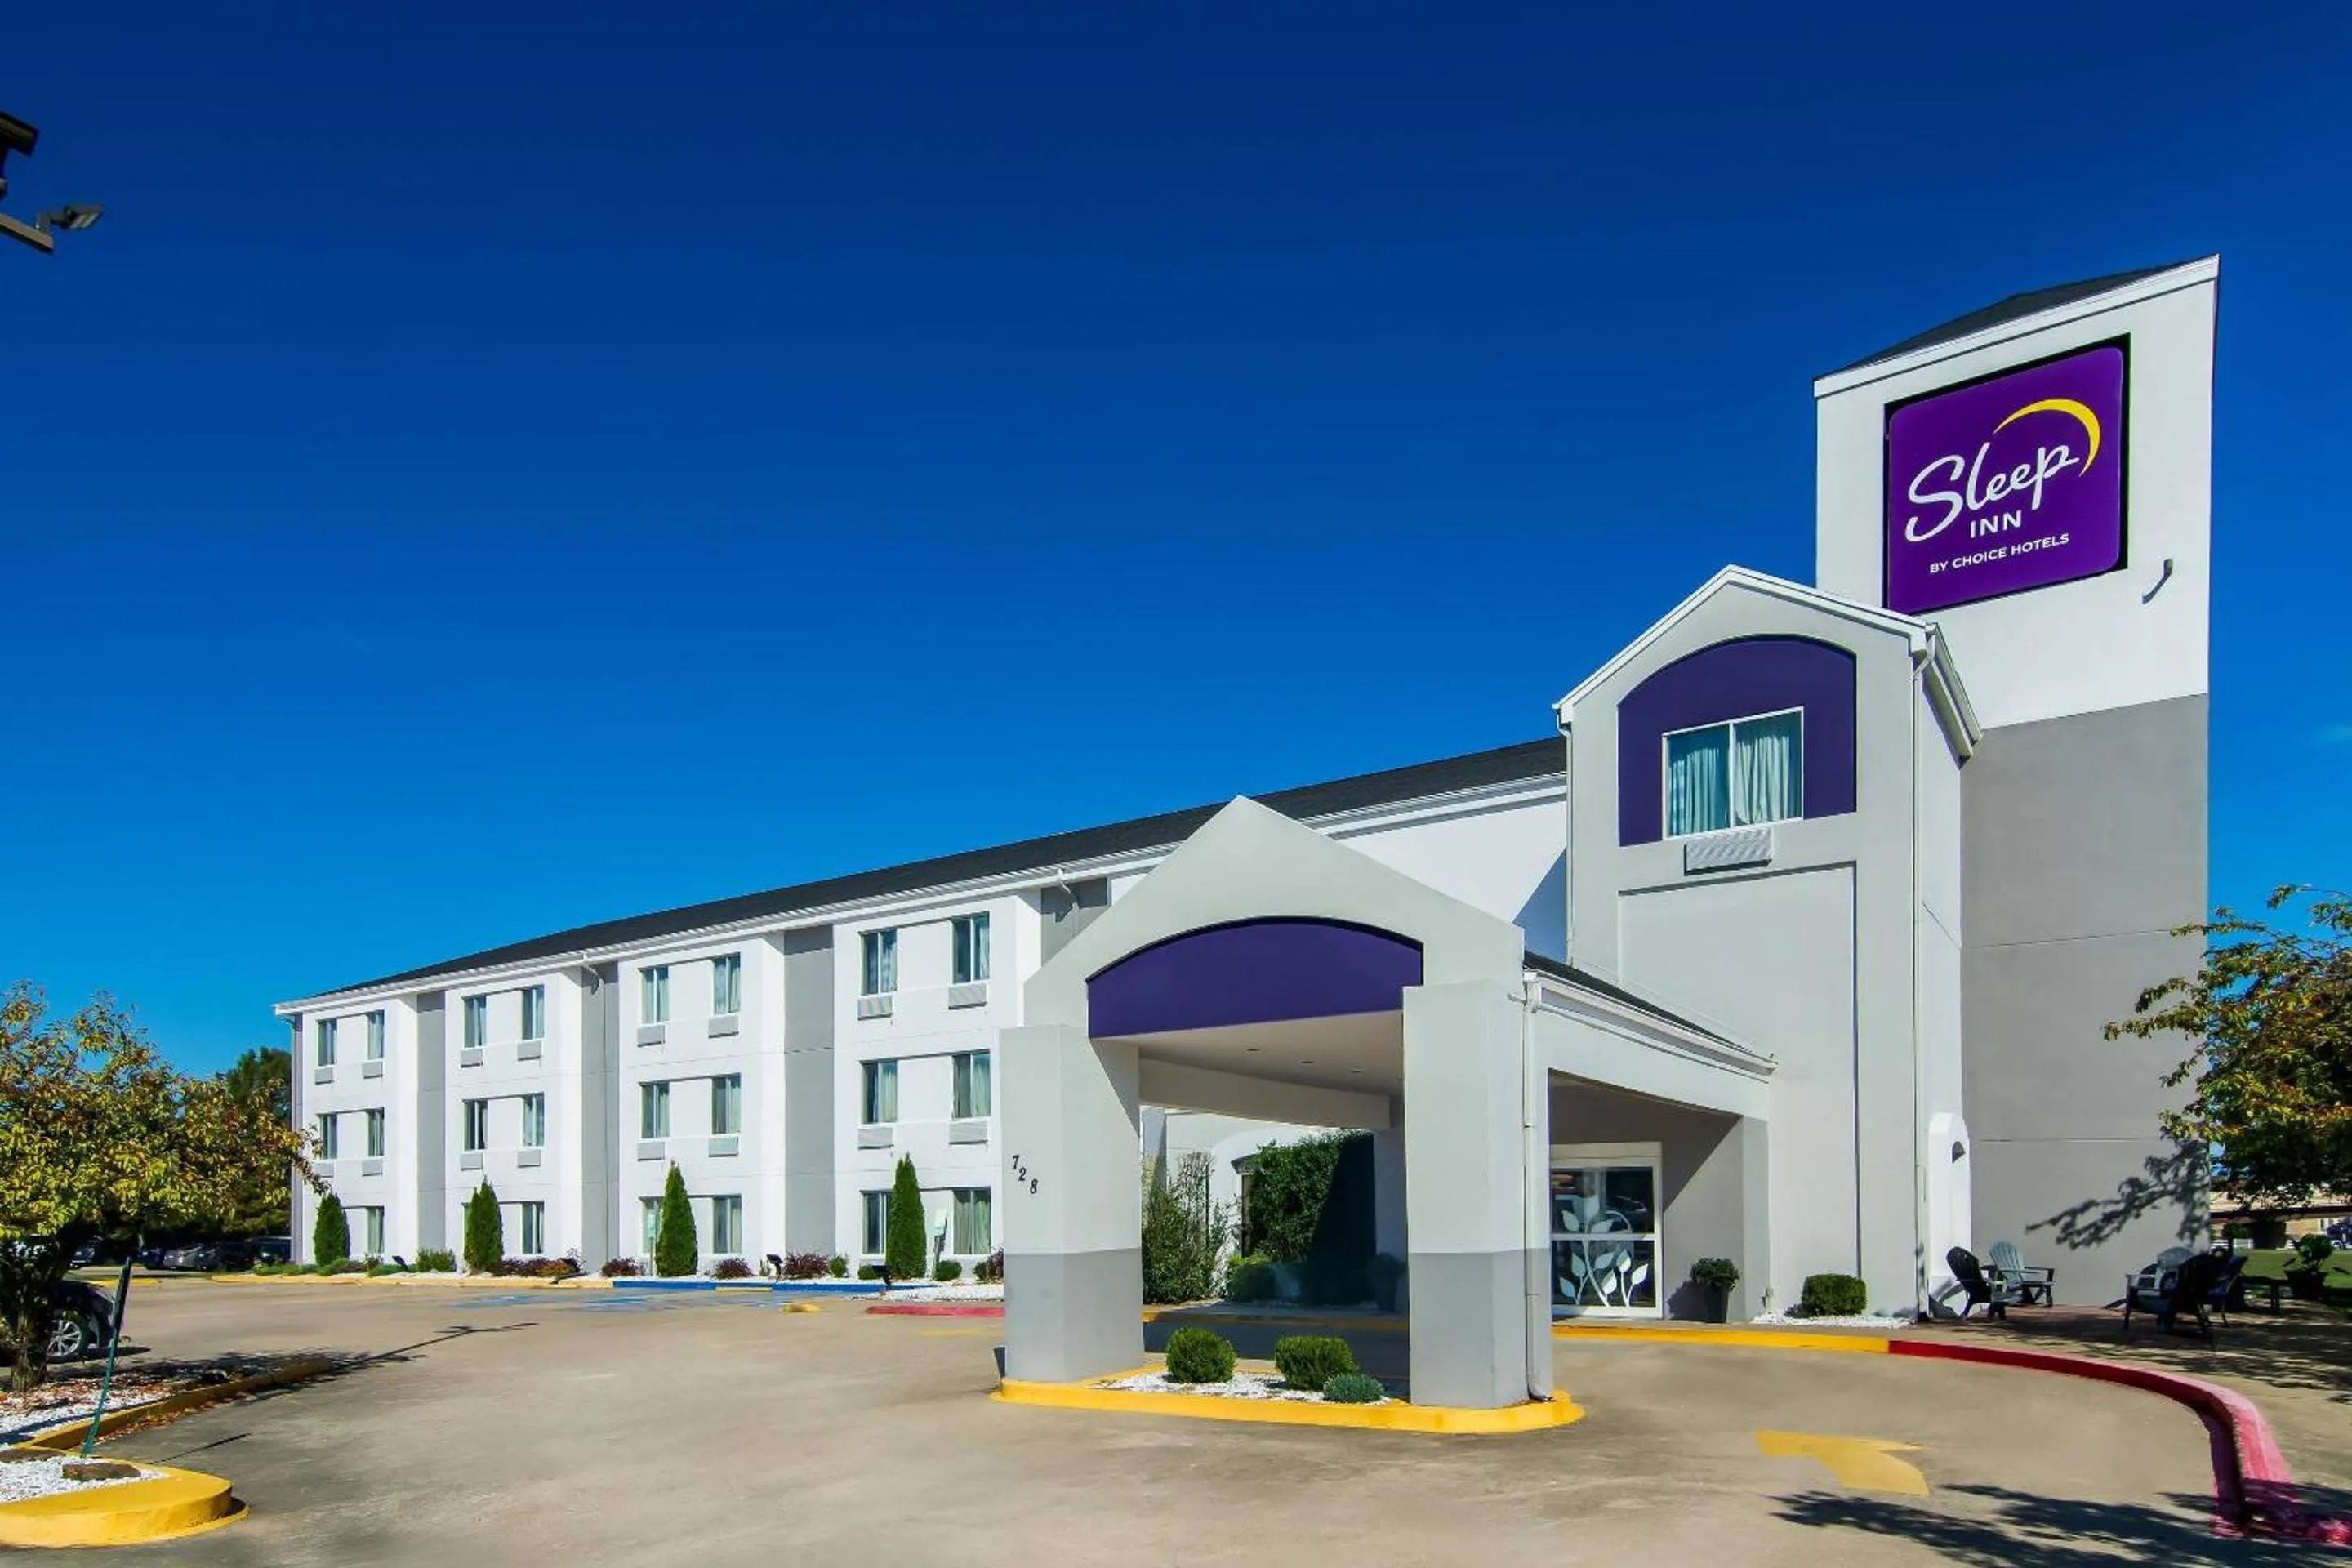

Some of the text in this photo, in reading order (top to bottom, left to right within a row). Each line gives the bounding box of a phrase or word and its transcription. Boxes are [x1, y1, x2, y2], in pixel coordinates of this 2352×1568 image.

[1904, 441, 2080, 542] Sleep
[1970, 509, 2023, 539] INN
[1929, 532, 2070, 574] BY CHOICE HOTELS
[1012, 1154, 1038, 1194] 728
